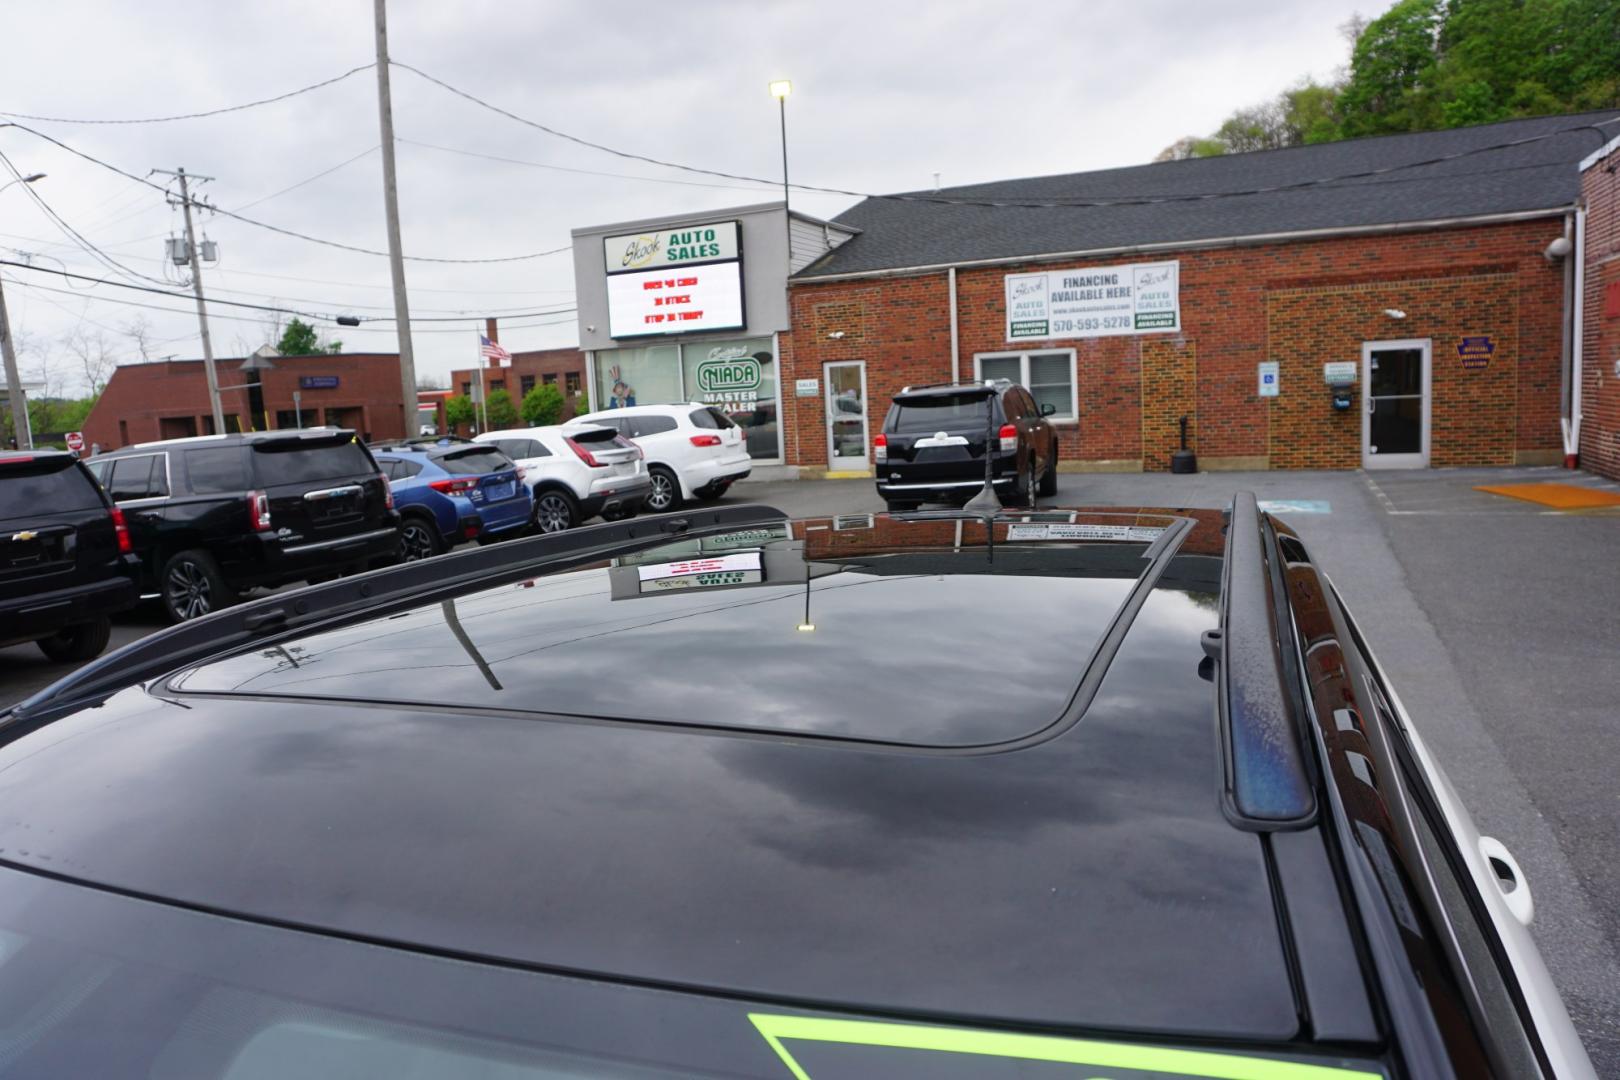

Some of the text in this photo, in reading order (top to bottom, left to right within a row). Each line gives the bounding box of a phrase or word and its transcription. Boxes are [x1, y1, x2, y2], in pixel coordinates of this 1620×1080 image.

[669, 229, 716, 246] AUTO
[622, 234, 661, 266] Skook
[667, 243, 720, 261] SALES
[1063, 273, 1118, 289] FINANCING
[1051, 286, 1132, 303] AVAILABLE HERE
[1141, 291, 1170, 300] AUTO
[1016, 301, 1044, 309] AUTO
[1137, 300, 1172, 309] SALES
[1013, 309, 1046, 318] SALES
[1053, 315, 1131, 332] 570-593-5278
[1137, 319, 1173, 328] AVAILABLE
[1012, 327, 1047, 336] AVAILABLE
[703, 365, 754, 385] NIADA
[703, 391, 757, 403] MASTER
[718, 401, 757, 413] ALER
